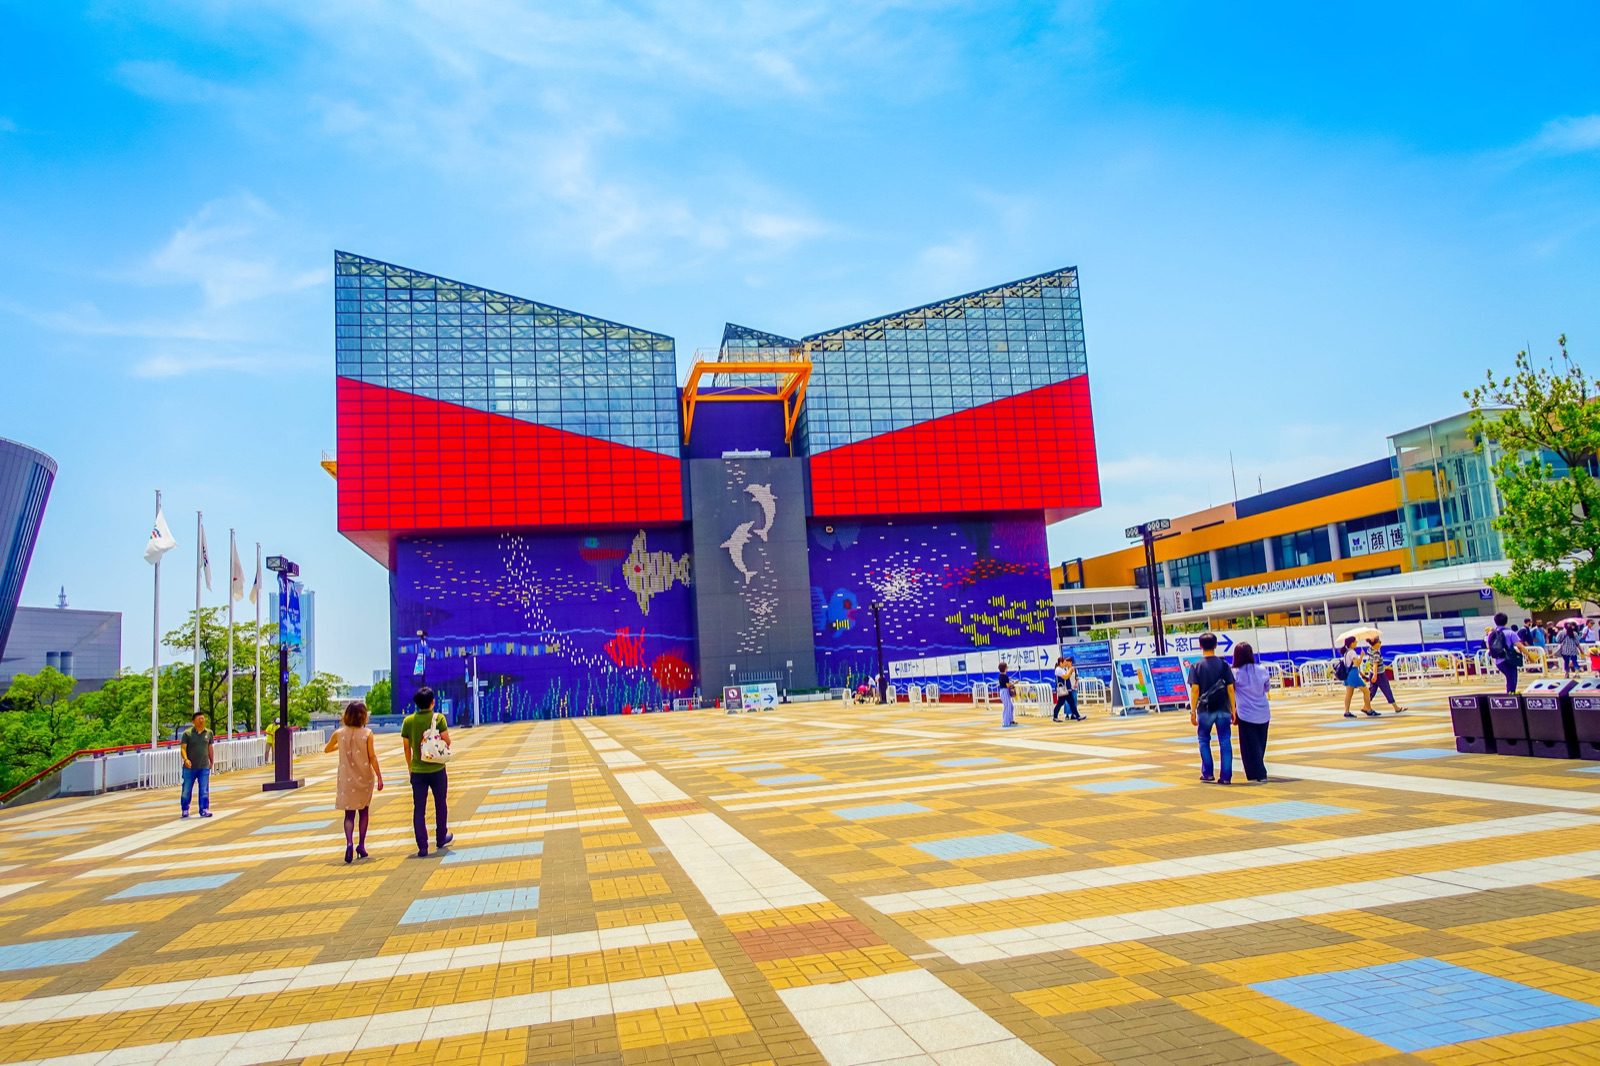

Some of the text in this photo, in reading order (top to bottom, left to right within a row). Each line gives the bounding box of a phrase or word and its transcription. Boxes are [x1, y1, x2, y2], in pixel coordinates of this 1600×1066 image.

[1232, 585, 1256, 597] OSAKA
[1256, 579, 1293, 593] AQUARIUM
[1294, 572, 1336, 588] KAIYUKAN
